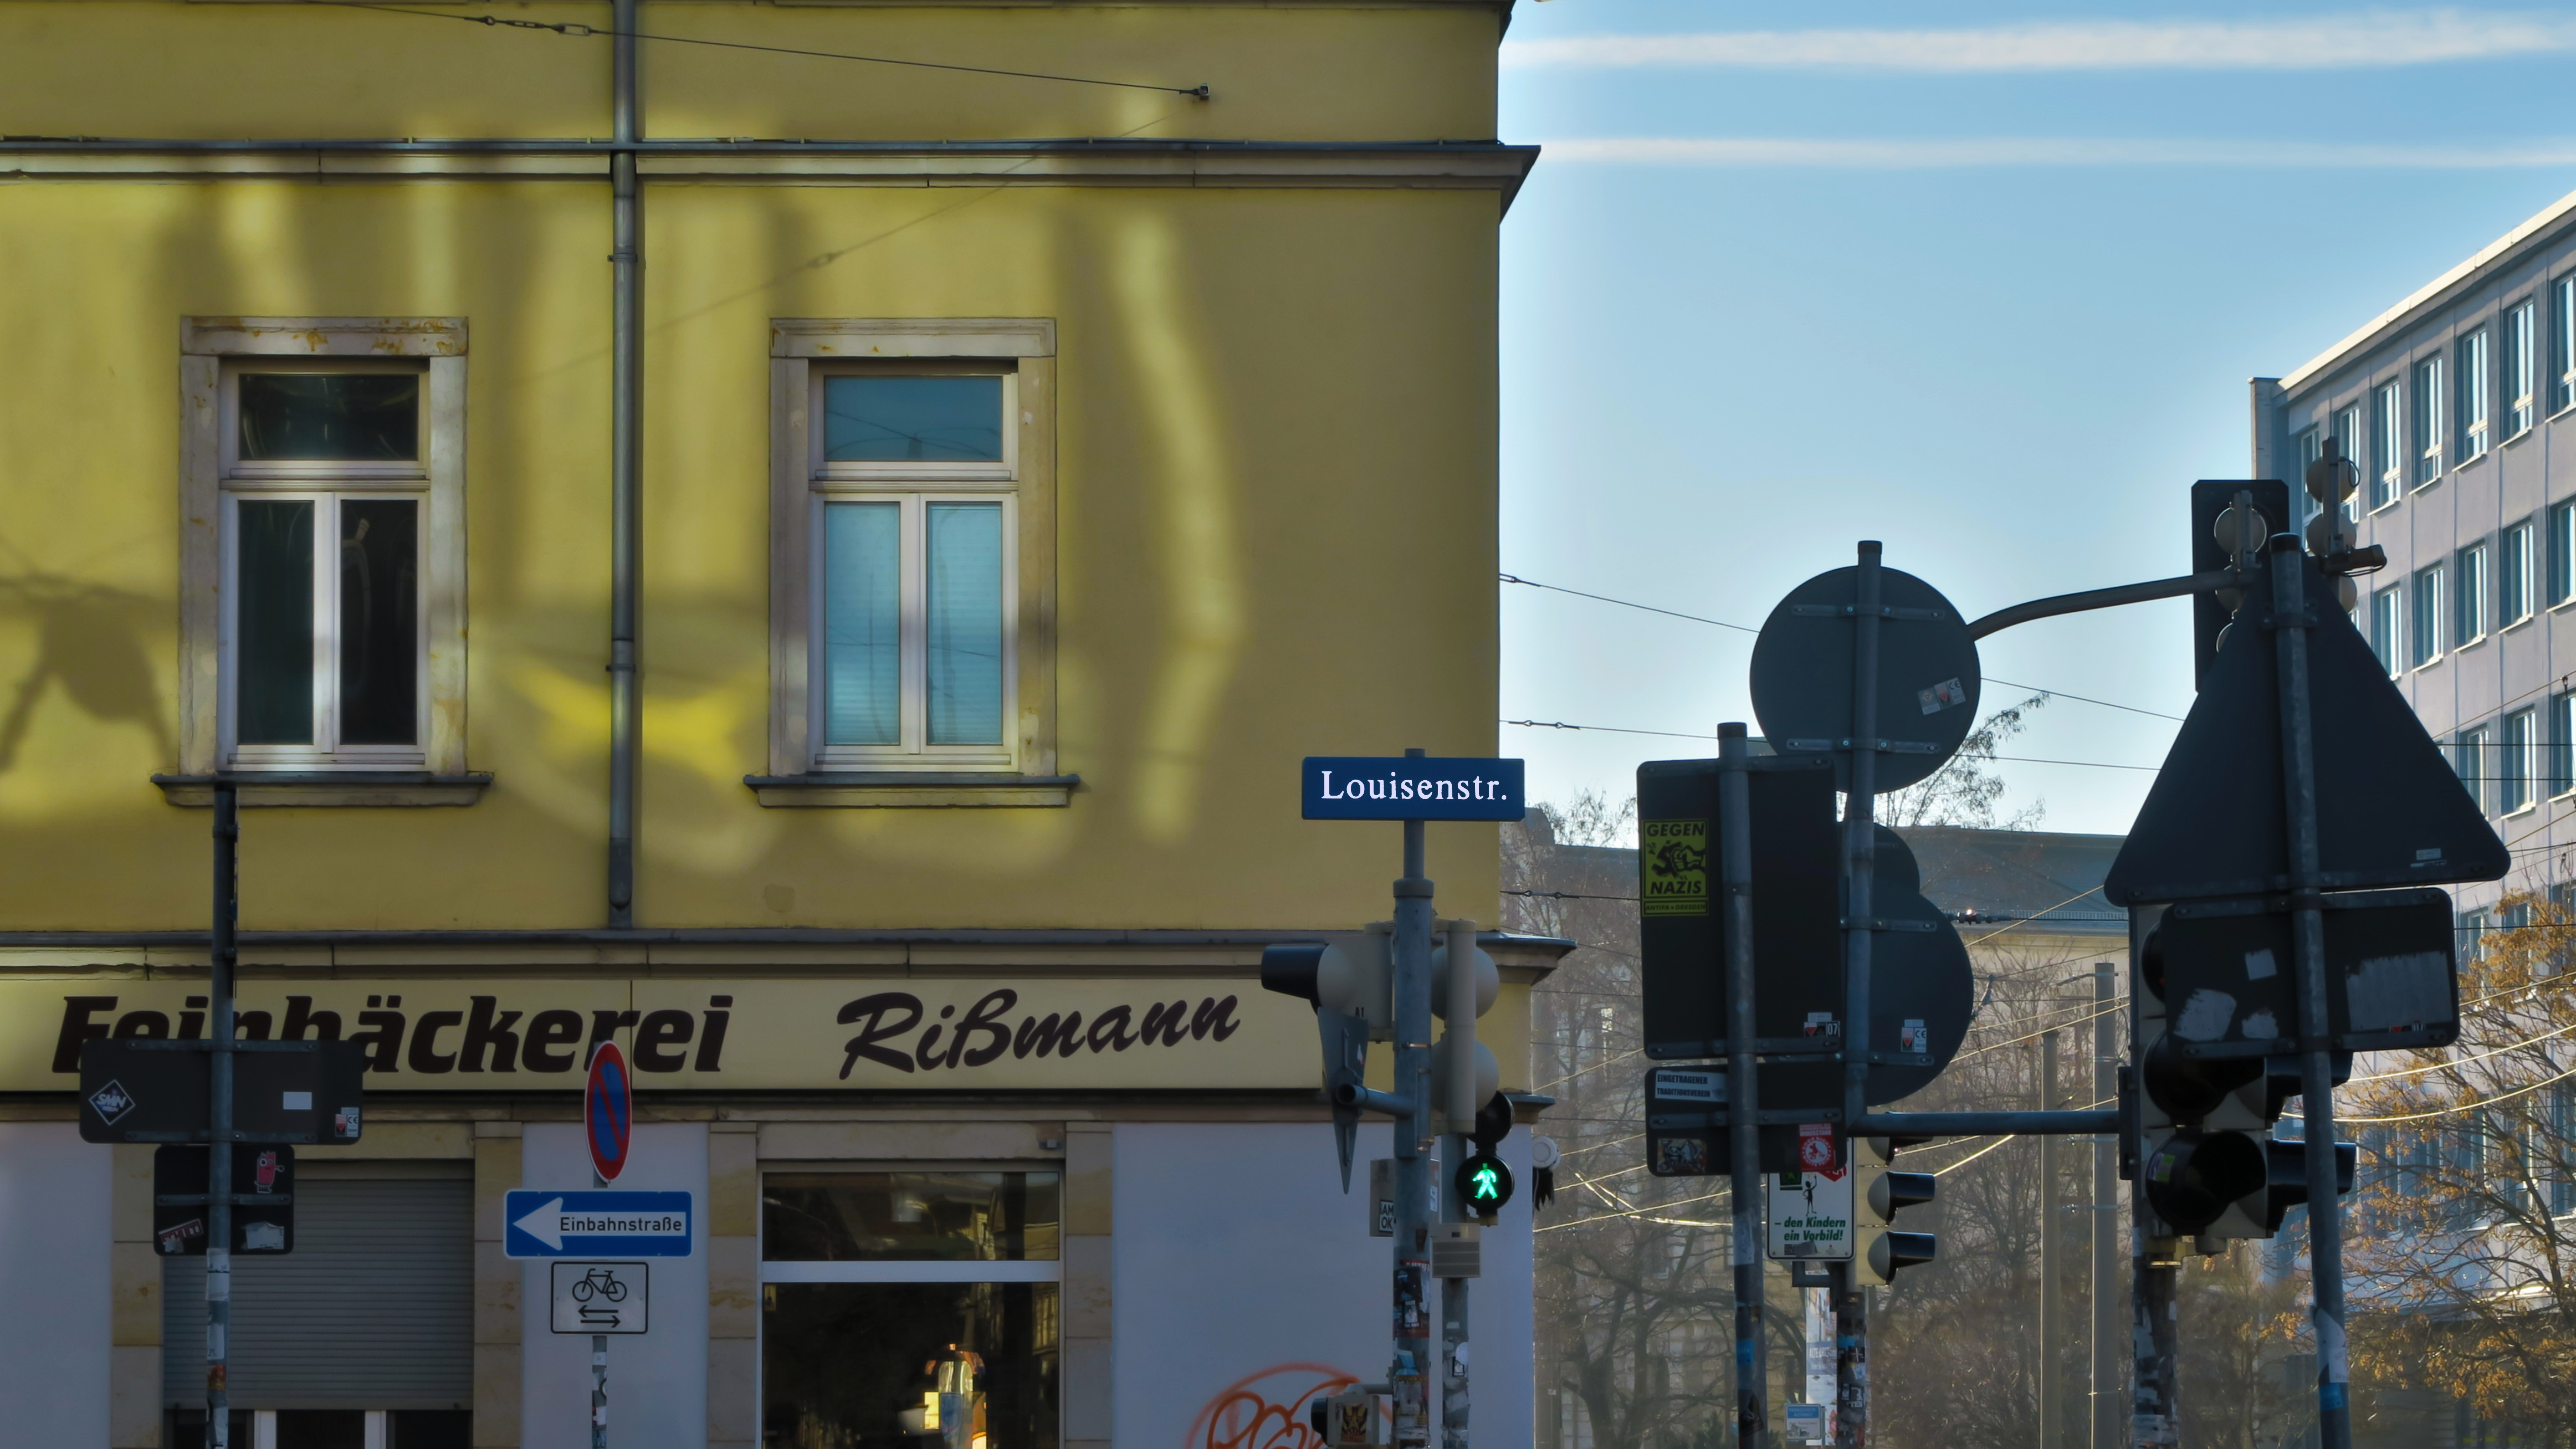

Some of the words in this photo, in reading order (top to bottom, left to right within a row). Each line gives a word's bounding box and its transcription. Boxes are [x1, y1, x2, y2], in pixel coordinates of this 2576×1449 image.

[1321, 770, 1507, 800] Louisenstr.
[1647, 823, 1704, 837] GEGEN
[1651, 880, 1701, 894] NAZIS
[837, 989, 1241, 1080] Rißmann
[1827, 1023, 1837, 1035] 07
[1657, 1074, 1708, 1084] EINGETRAGENER
[1657, 1088, 1710, 1097] TRADITIONSVEREIN
[560, 1216, 682, 1231] Einbahnstraße
[1784, 1216, 1803, 1227] den
[1806, 1216, 1846, 1227] Kindern
[1784, 1230, 1799, 1241] ein
[1803, 1230, 1843, 1241] Vorbild!
